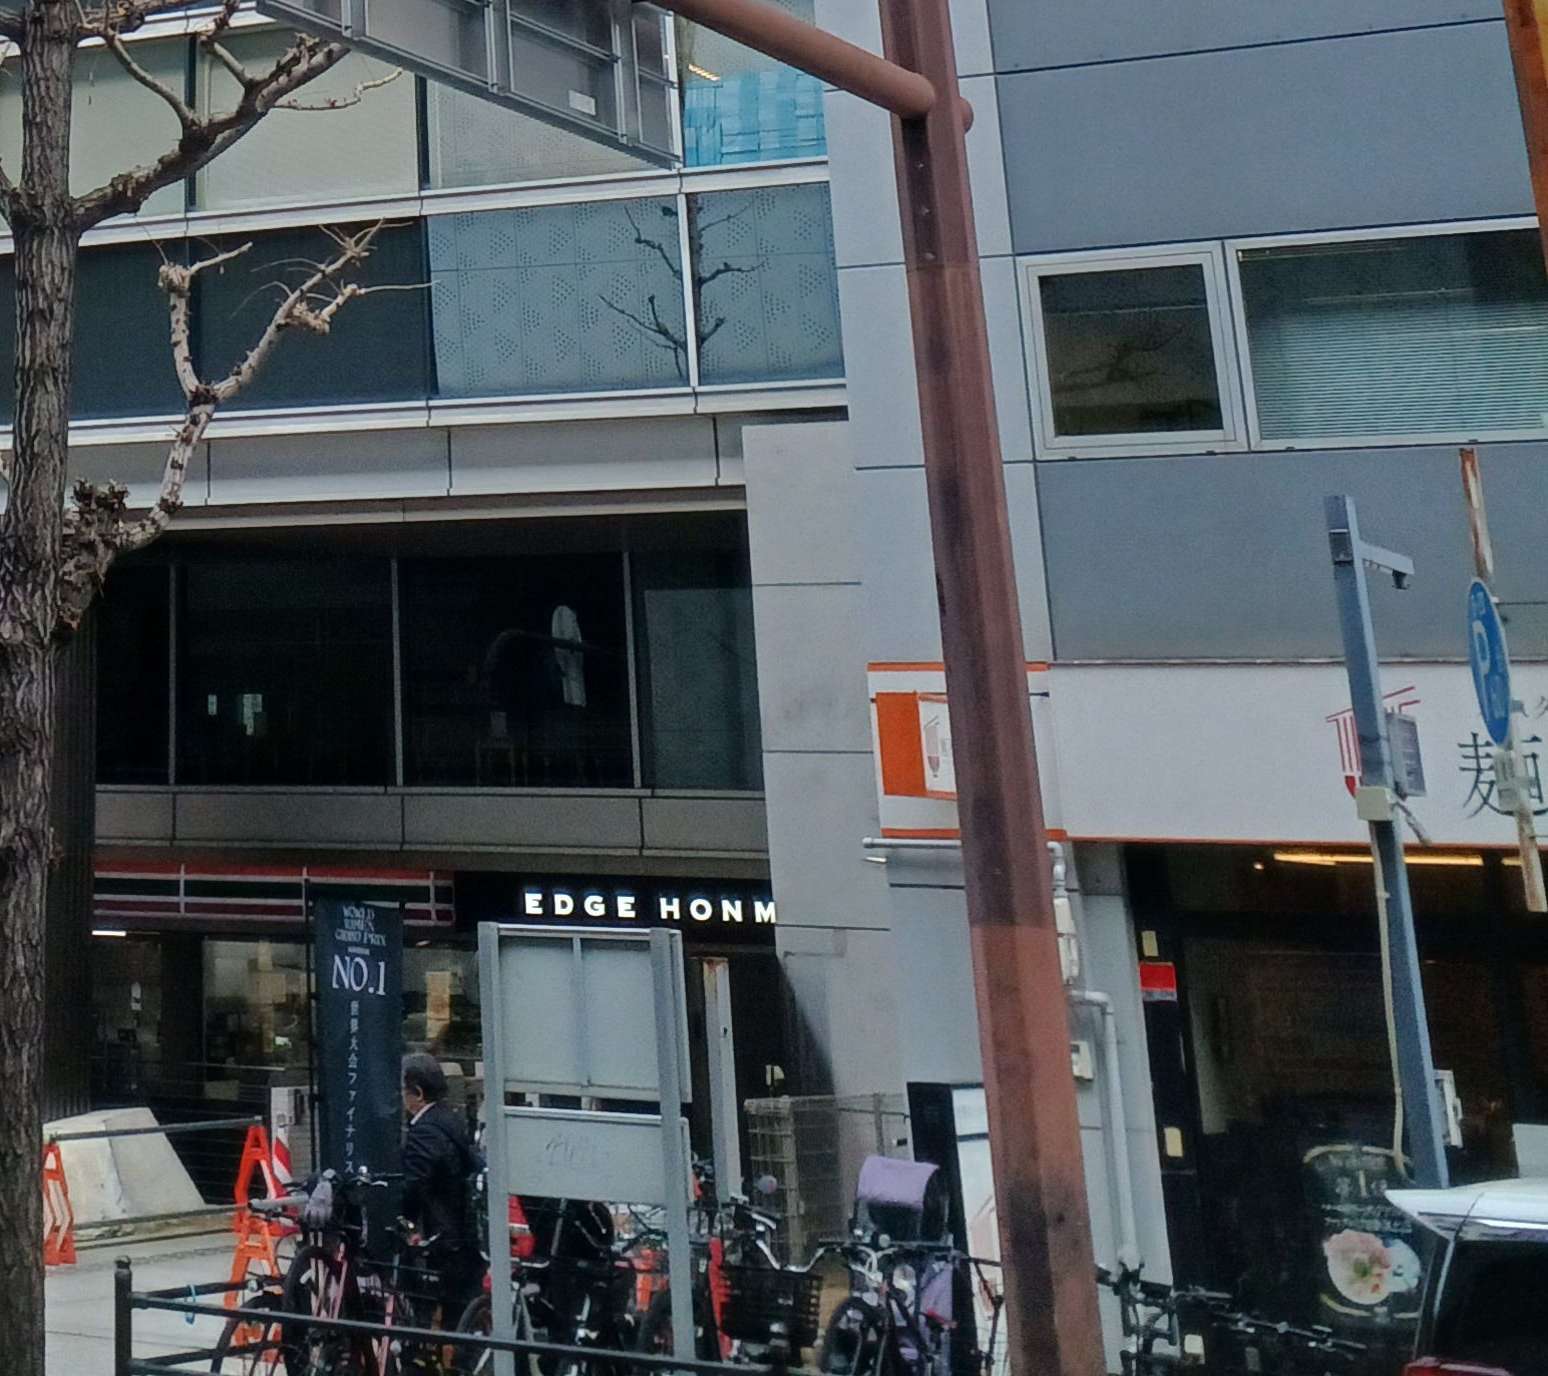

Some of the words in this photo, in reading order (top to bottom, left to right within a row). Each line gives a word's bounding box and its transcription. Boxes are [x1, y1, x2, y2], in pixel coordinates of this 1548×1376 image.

[525, 892, 636, 919] EDGE
[659, 897, 777, 924] HONM
[332, 954, 386, 996] NO.1
